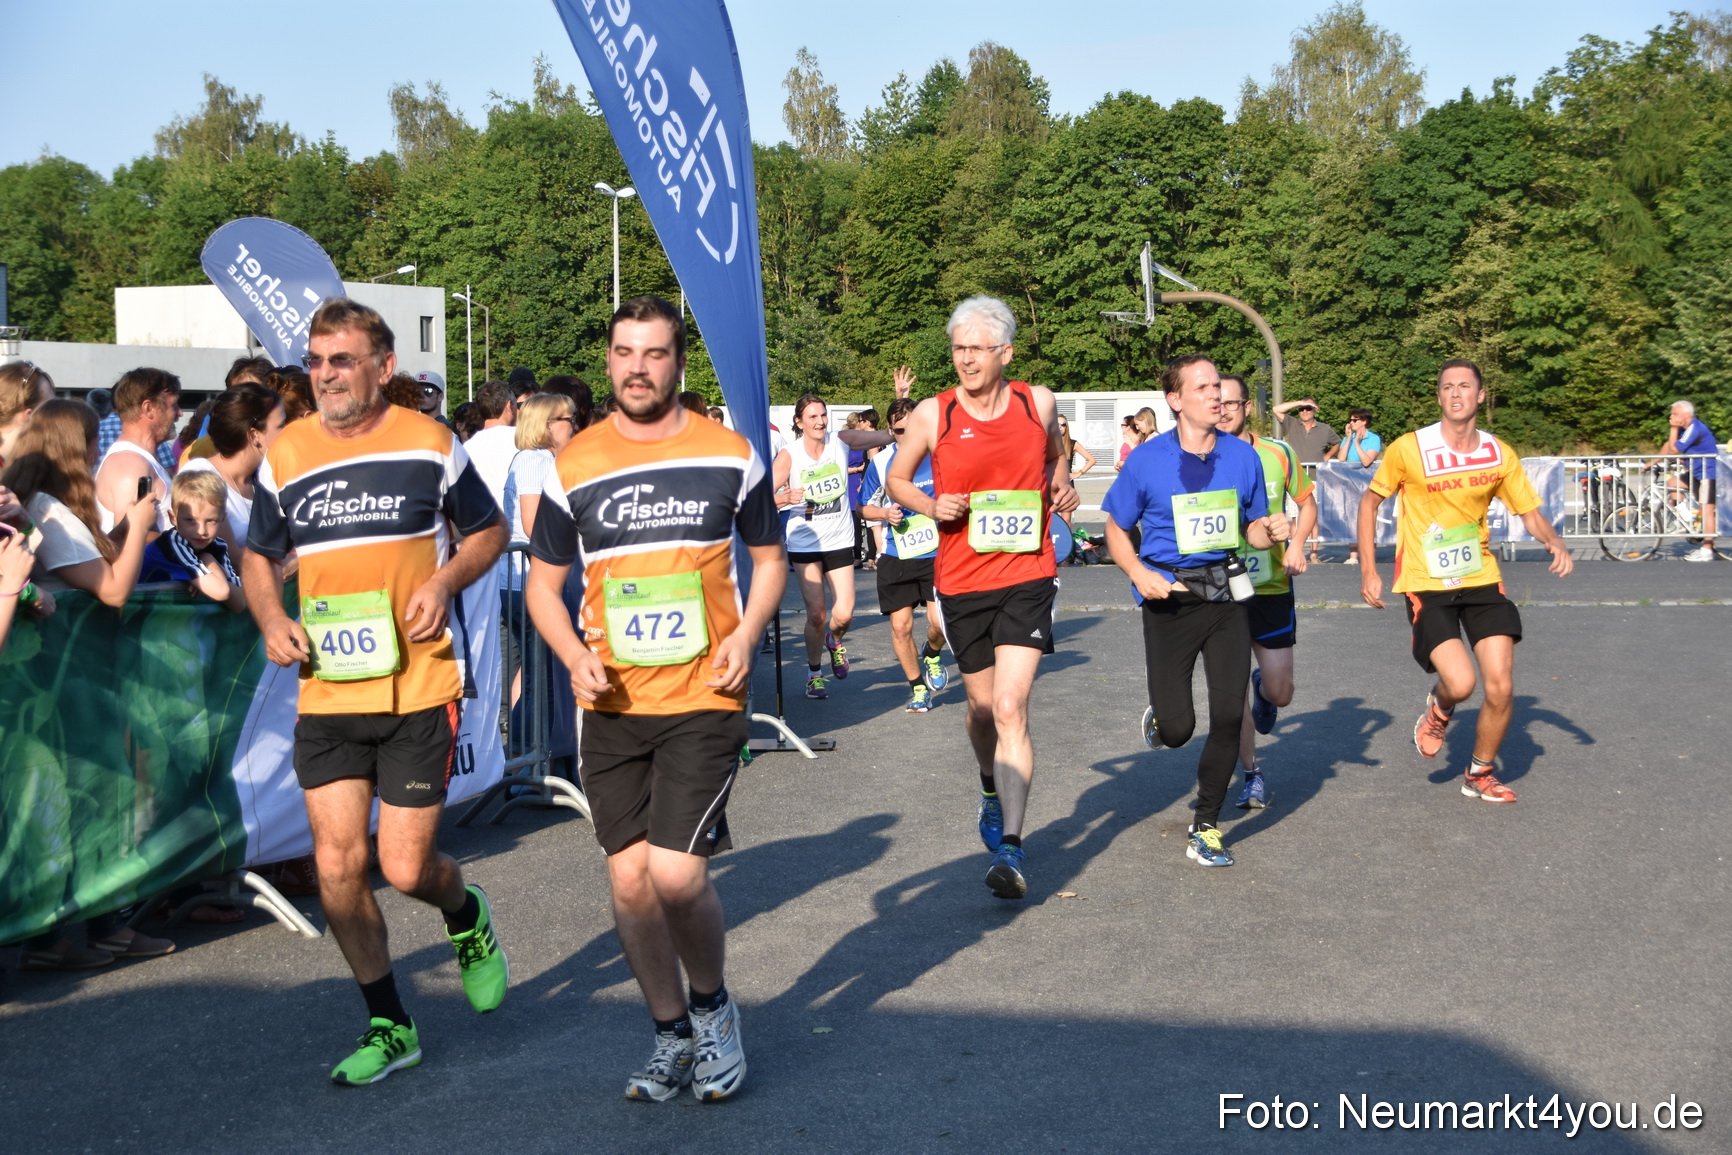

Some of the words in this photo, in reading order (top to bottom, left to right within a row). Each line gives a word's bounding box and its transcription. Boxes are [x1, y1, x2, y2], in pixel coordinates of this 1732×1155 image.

[808, 478, 840, 496] 1153
[1426, 478, 1463, 493] MAX
[1468, 472, 1504, 487] BÖGL
[308, 483, 406, 520] Fischer
[617, 486, 710, 521] Fischer
[318, 512, 400, 528] AUTOMOBILE
[627, 516, 703, 531] AUTOMOBILE
[977, 516, 1034, 536] 1382
[1189, 515, 1226, 536] 750
[900, 528, 934, 549] 1320
[1438, 545, 1472, 568] 876
[624, 610, 687, 642] 472
[320, 627, 377, 657] 406
[414, 782, 431, 790] asics
